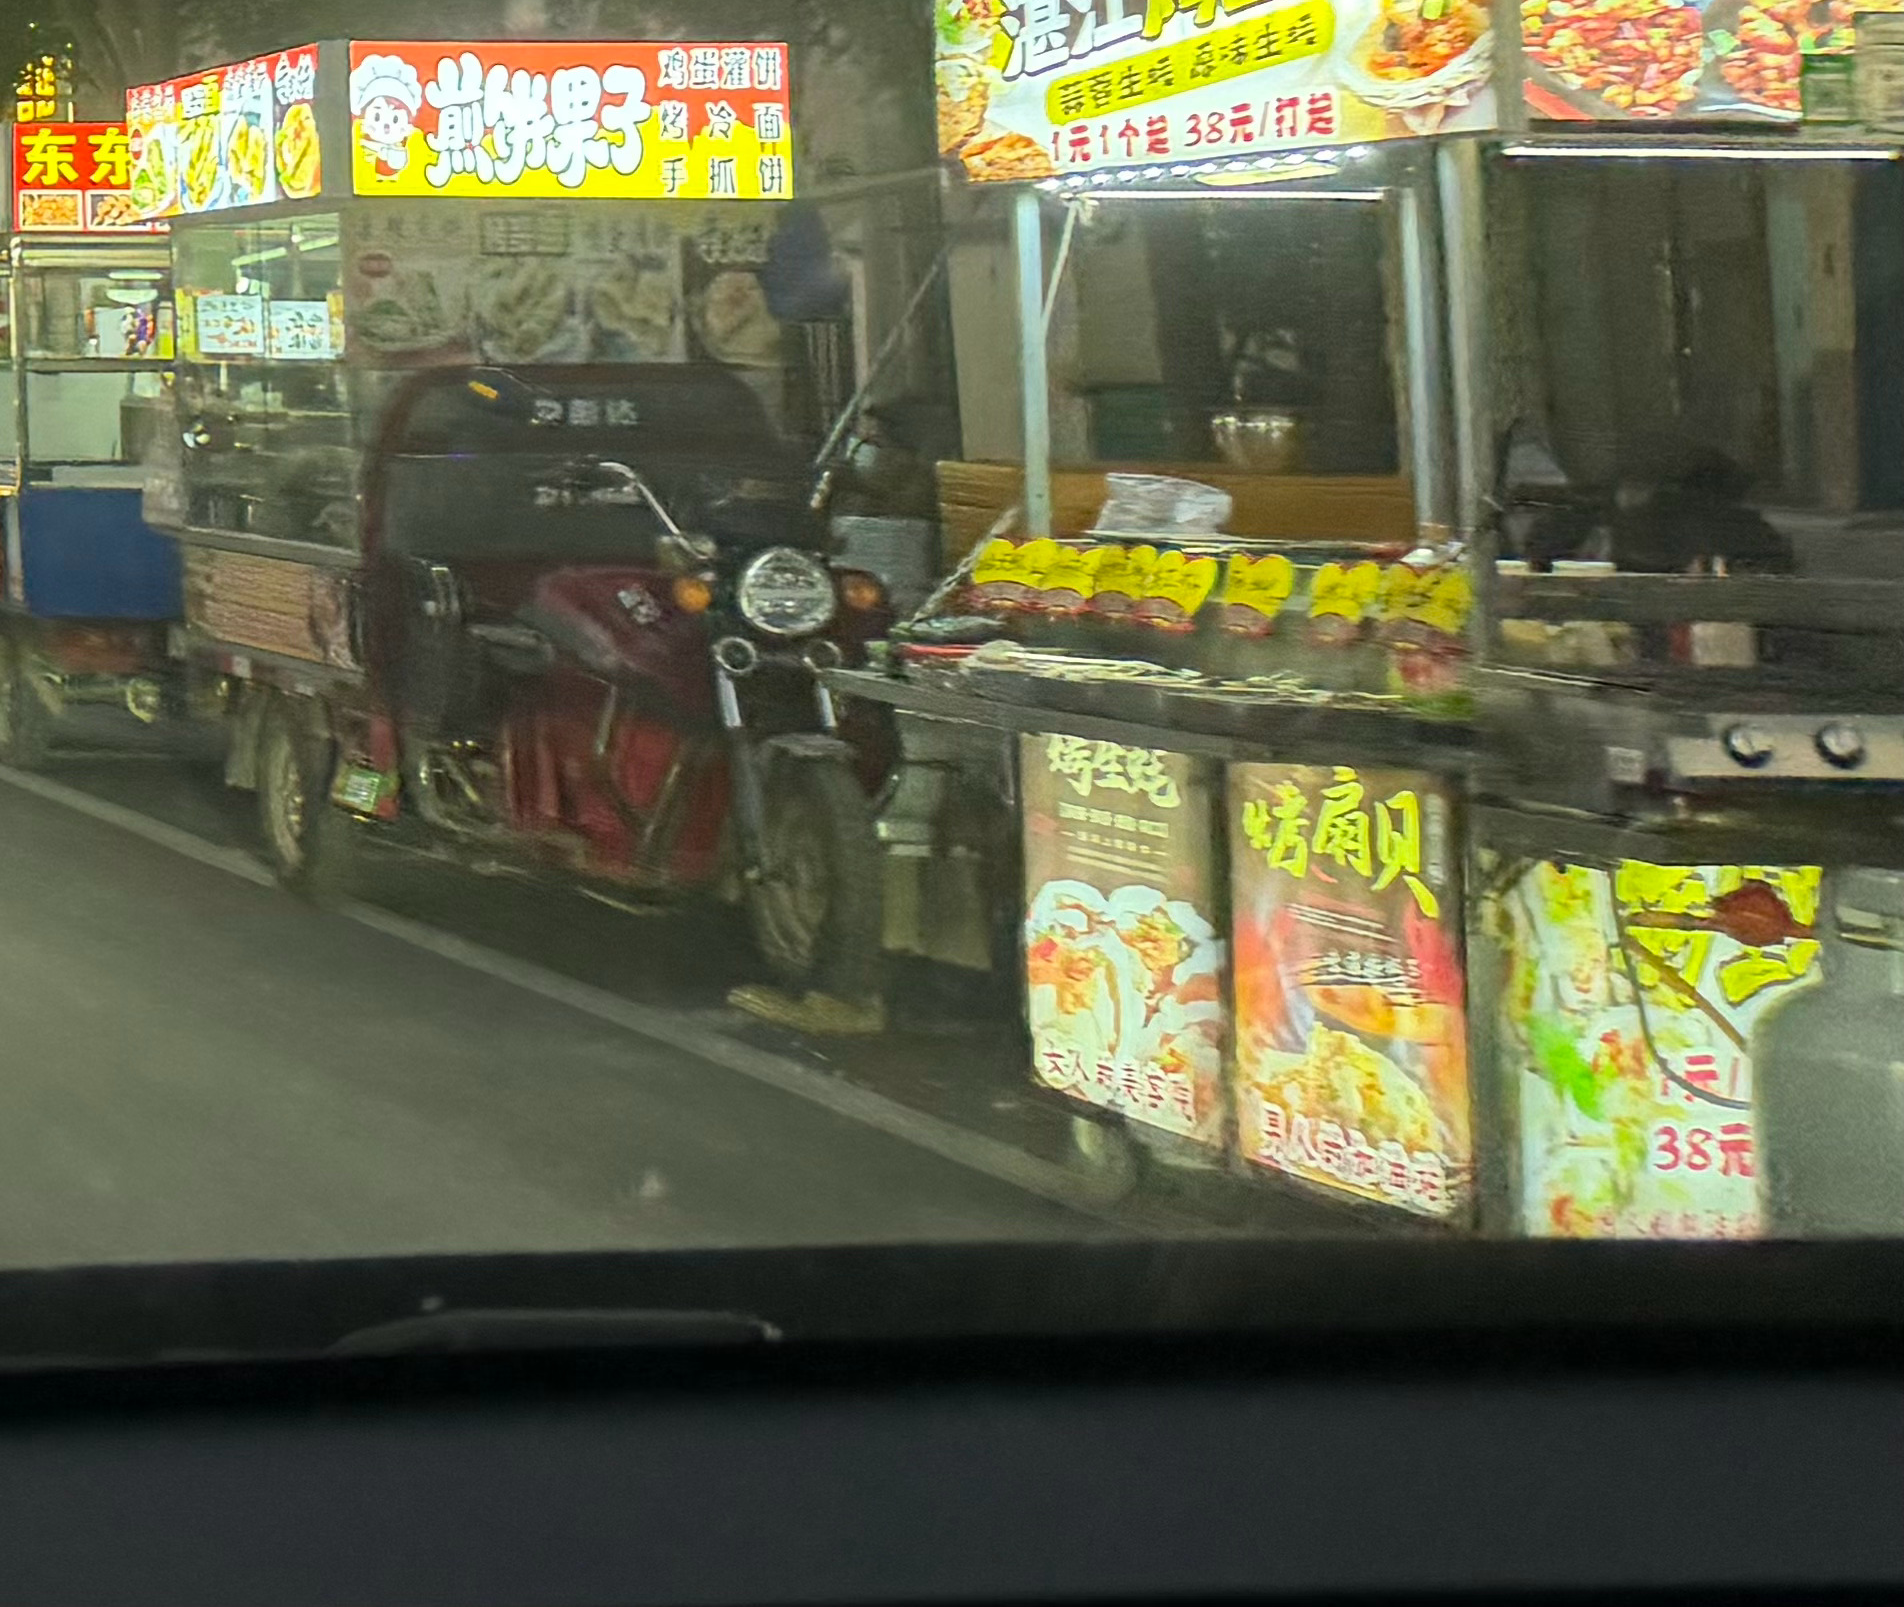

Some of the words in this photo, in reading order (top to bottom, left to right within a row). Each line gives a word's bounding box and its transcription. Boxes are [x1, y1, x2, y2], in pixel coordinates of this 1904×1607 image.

[657, 47, 782, 90] 鸡蛋灌饼
[424, 51, 652, 188] 煎饼果子
[658, 100, 784, 142] 烤冷面
[660, 156, 784, 195] 手抓饼
[1241, 765, 1440, 919] 烤扇贝
